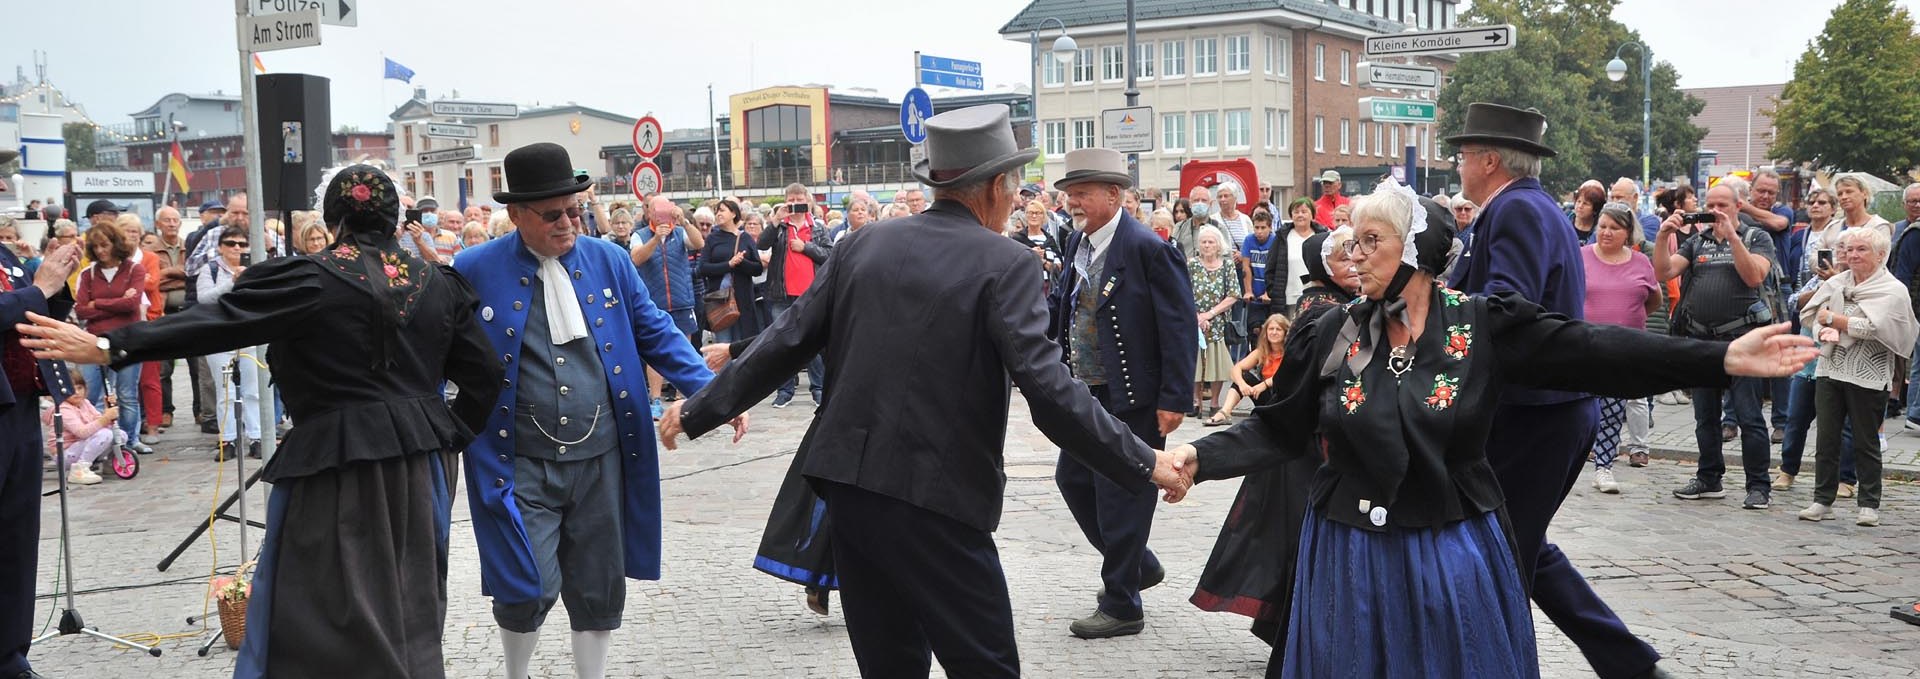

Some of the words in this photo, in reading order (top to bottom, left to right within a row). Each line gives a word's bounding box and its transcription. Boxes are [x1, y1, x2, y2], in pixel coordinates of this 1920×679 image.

[253, 24, 271, 44] Am
[275, 21, 314, 41] Strom
[1373, 40, 1408, 51] Kleine
[1411, 37, 1462, 49] Komödie
[1384, 72, 1422, 82] Heimatmuseum
[437, 104, 455, 113] Fähre
[458, 105, 474, 113] Hohe
[477, 105, 492, 113] Düne
[84, 177, 109, 187] Alter
[112, 177, 144, 187] Strom
